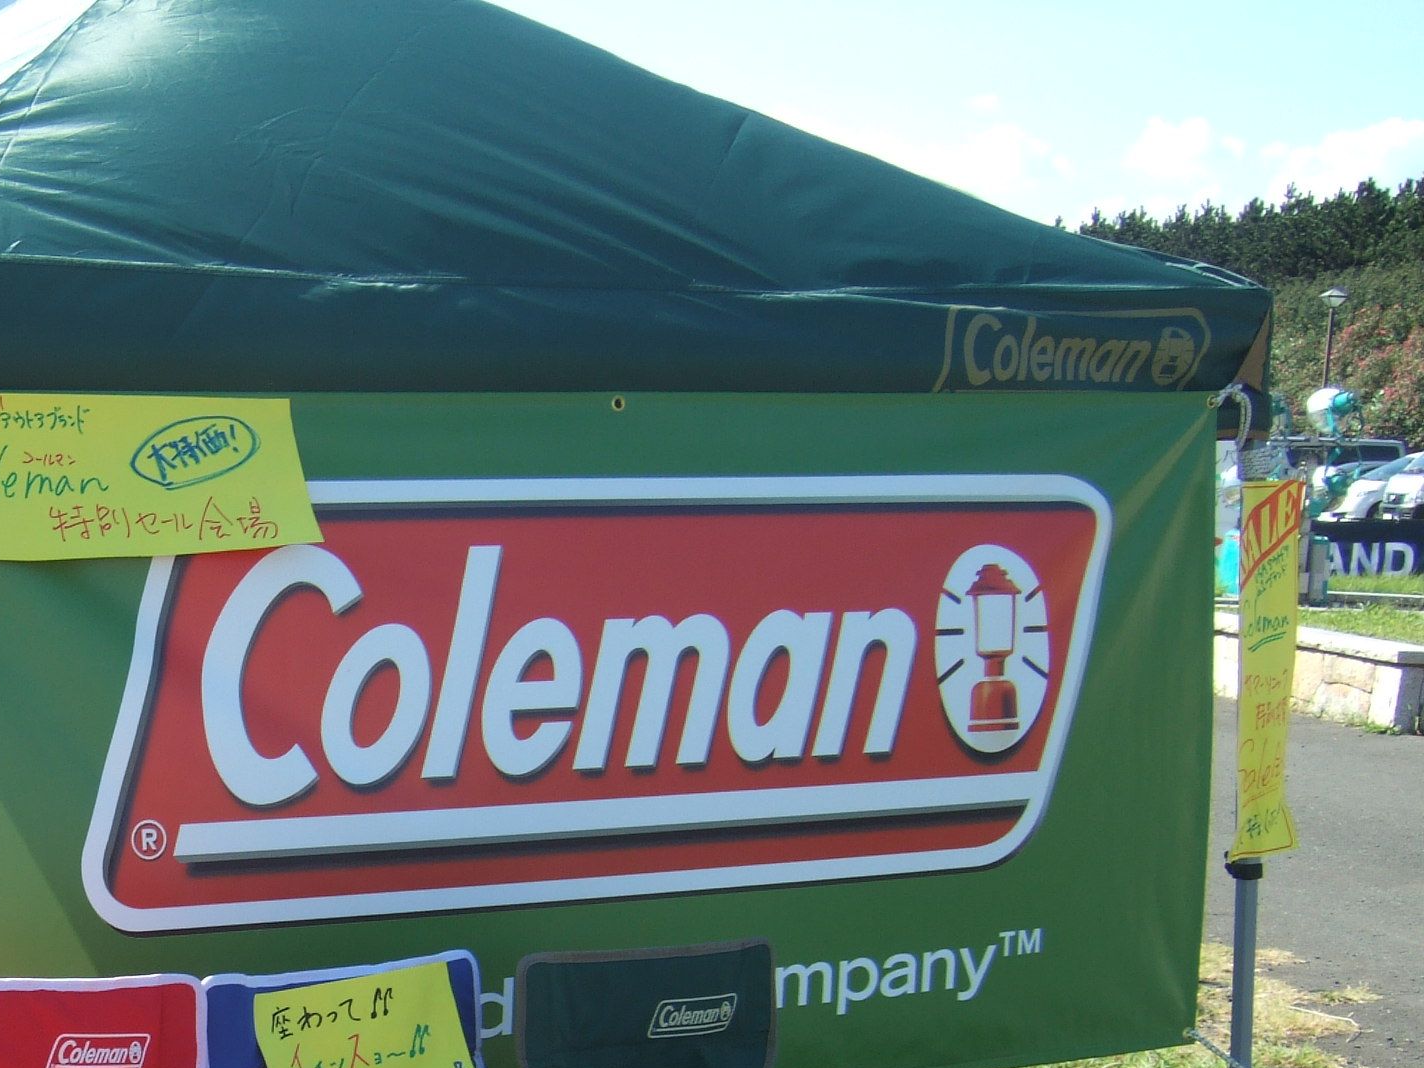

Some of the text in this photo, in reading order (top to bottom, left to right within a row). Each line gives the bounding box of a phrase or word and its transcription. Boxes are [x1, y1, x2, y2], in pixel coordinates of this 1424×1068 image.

[964, 313, 1150, 386] Coleman
[22, 451, 77, 468] コールマン
[49, 498, 278, 541] 特別セール会場
[201, 543, 917, 806] Coleman
[271, 999, 361, 1040] 座わって
[658, 1001, 718, 1029] Coleman
[58, 1040, 128, 1065] Coleman
